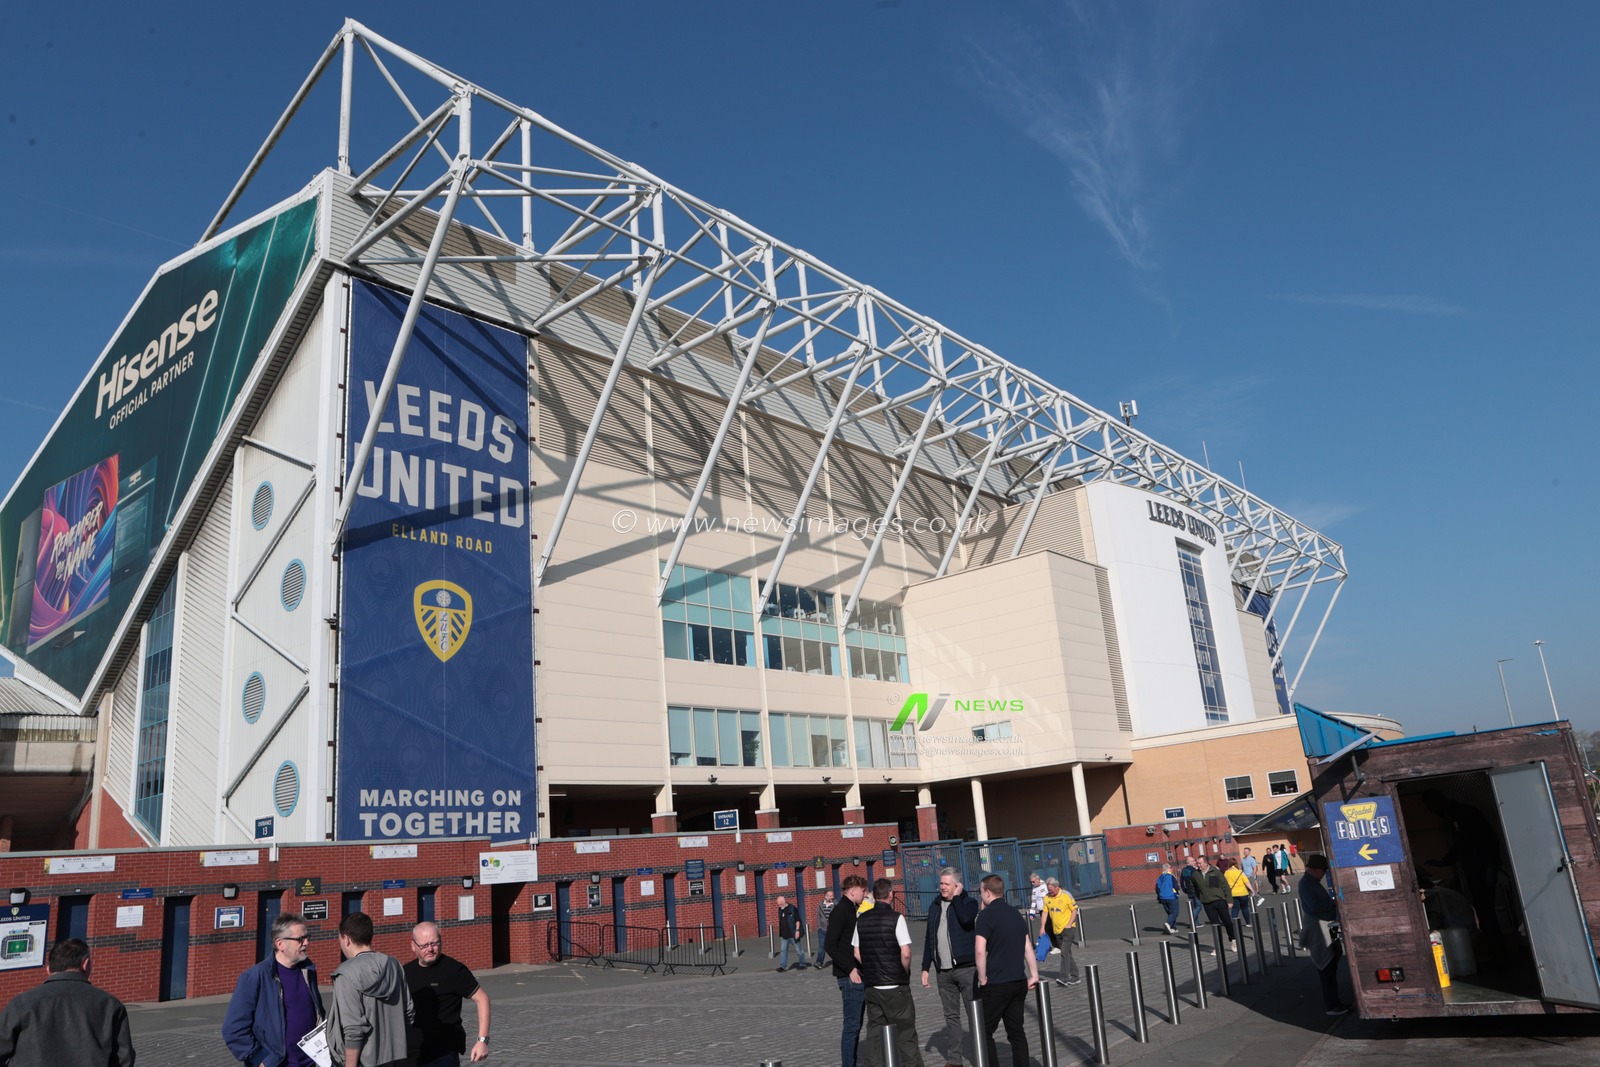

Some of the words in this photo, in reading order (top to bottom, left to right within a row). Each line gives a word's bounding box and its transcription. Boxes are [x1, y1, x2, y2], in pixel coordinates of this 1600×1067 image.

[95, 289, 219, 419] Hisense
[109, 388, 148, 430] OFFICIAL
[150, 351, 195, 398] PARTNER
[364, 380, 517, 464] LEEDS
[354, 442, 525, 528] UNITED
[1146, 500, 1186, 531] LEEDS
[391, 522, 448, 546] ELLAND
[455, 537, 493, 554] ROAD
[359, 789, 485, 807] MARCHING
[492, 790, 521, 807] ON
[1346, 804, 1373, 819] Loaded
[262, 826, 268, 836] 13
[359, 811, 521, 837] TOGETHER
[1338, 817, 1389, 839] FRIES
